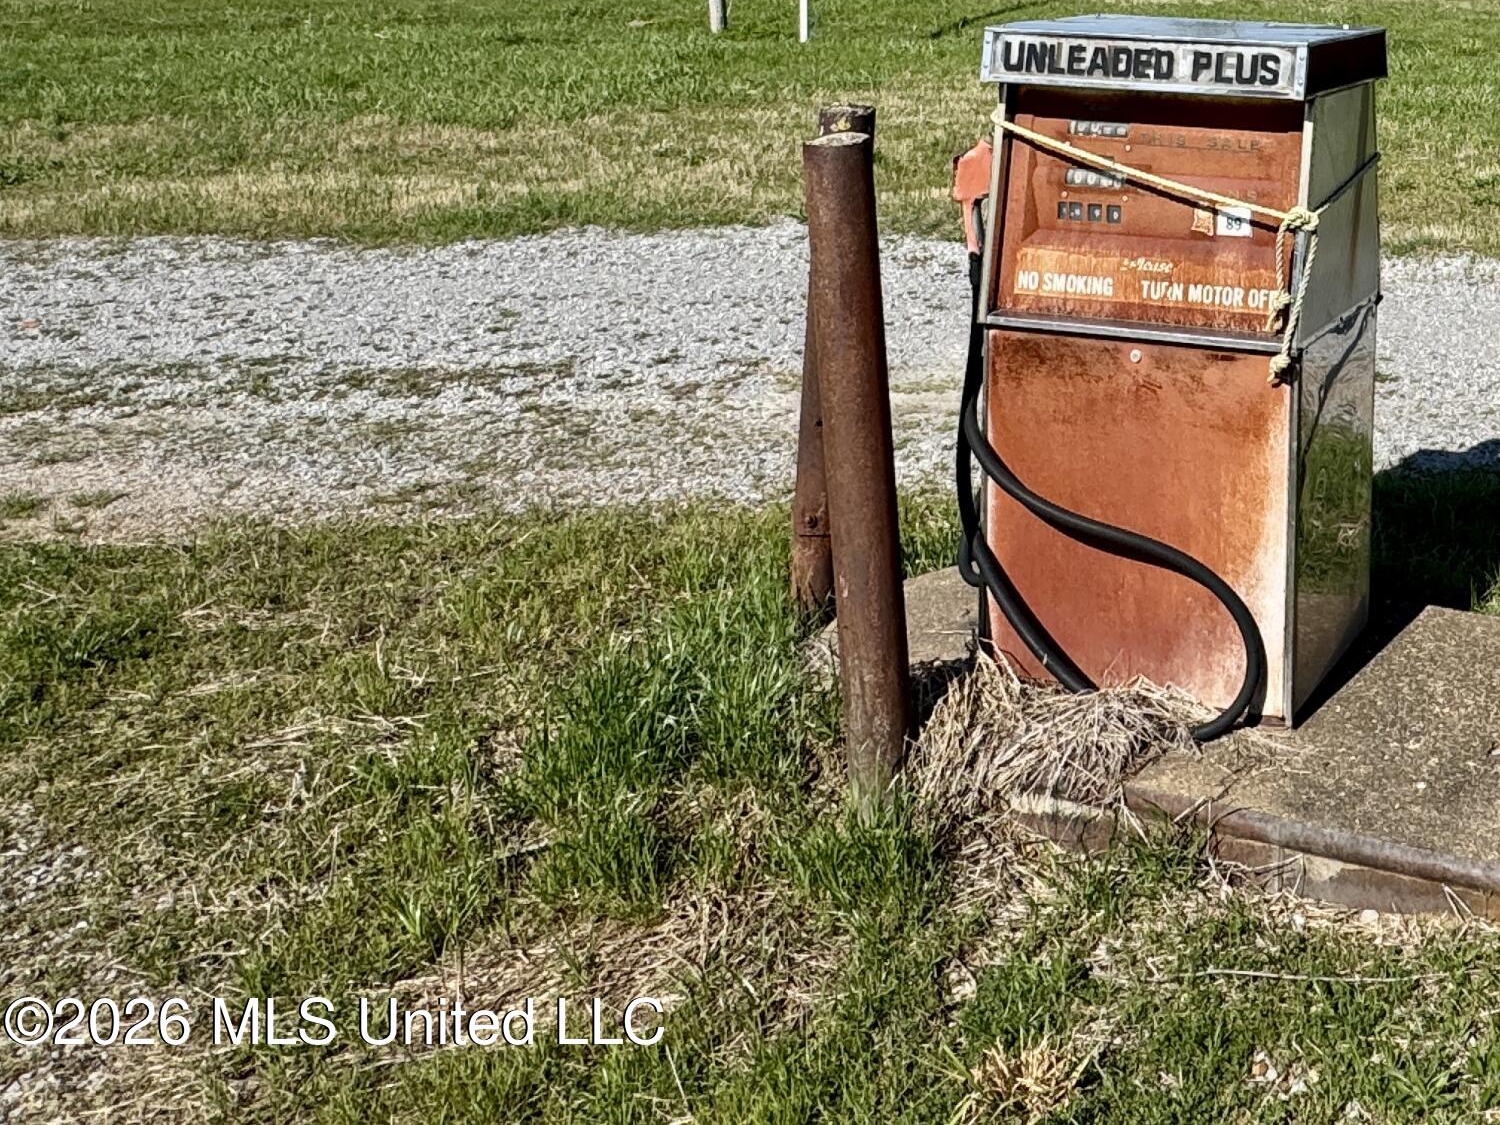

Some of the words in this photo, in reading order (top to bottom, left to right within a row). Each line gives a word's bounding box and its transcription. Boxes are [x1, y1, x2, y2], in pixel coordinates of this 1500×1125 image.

[1002, 40, 1175, 81] UNLEADED
[1190, 50, 1281, 86] PLUS
[1018, 269, 1040, 290] NO
[1042, 271, 1114, 297] SMOKING
[1187, 283, 1245, 307] MOTOR
